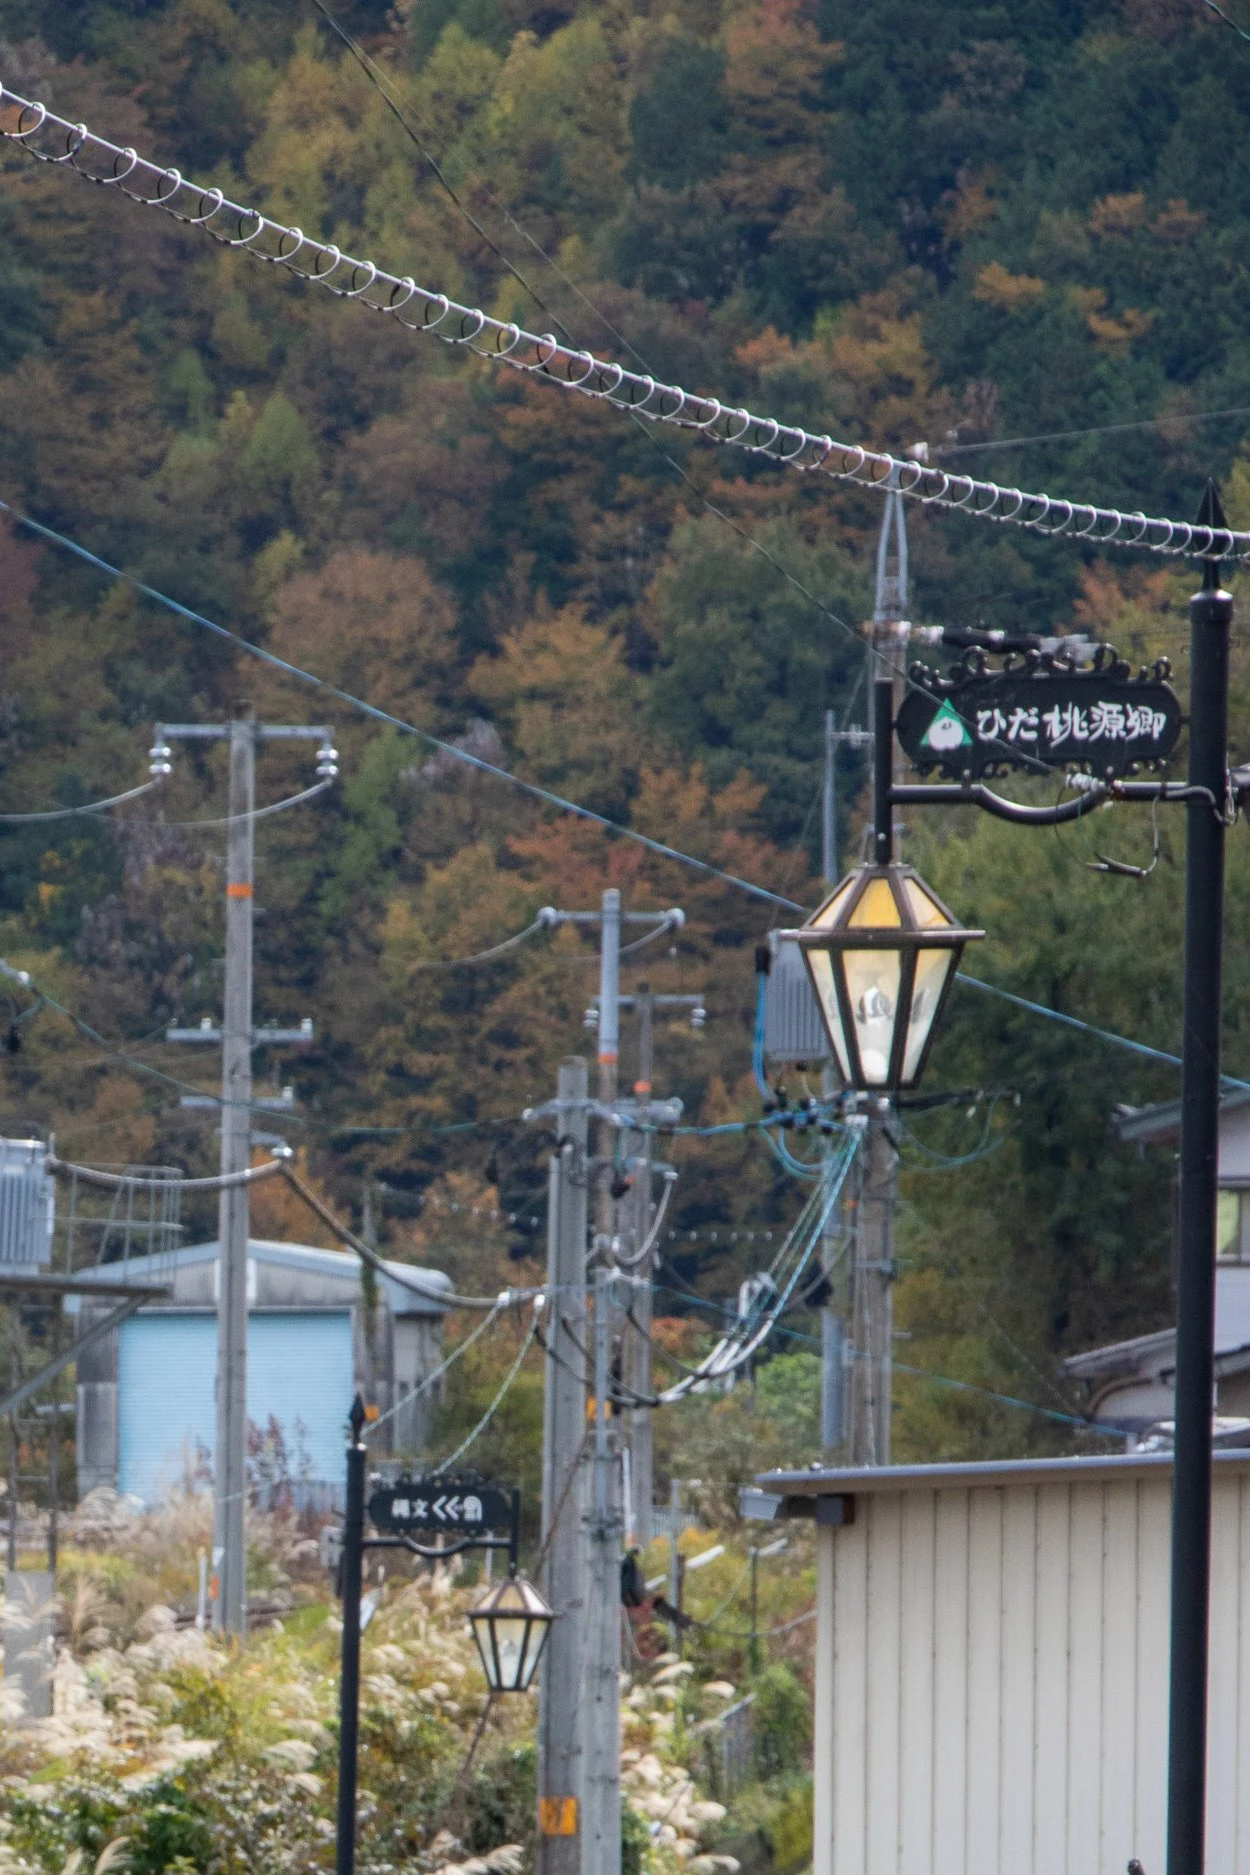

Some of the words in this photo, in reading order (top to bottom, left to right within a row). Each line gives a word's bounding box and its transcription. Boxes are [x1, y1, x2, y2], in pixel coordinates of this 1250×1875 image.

[976, 700, 1167, 749] ひだ桃源郷
